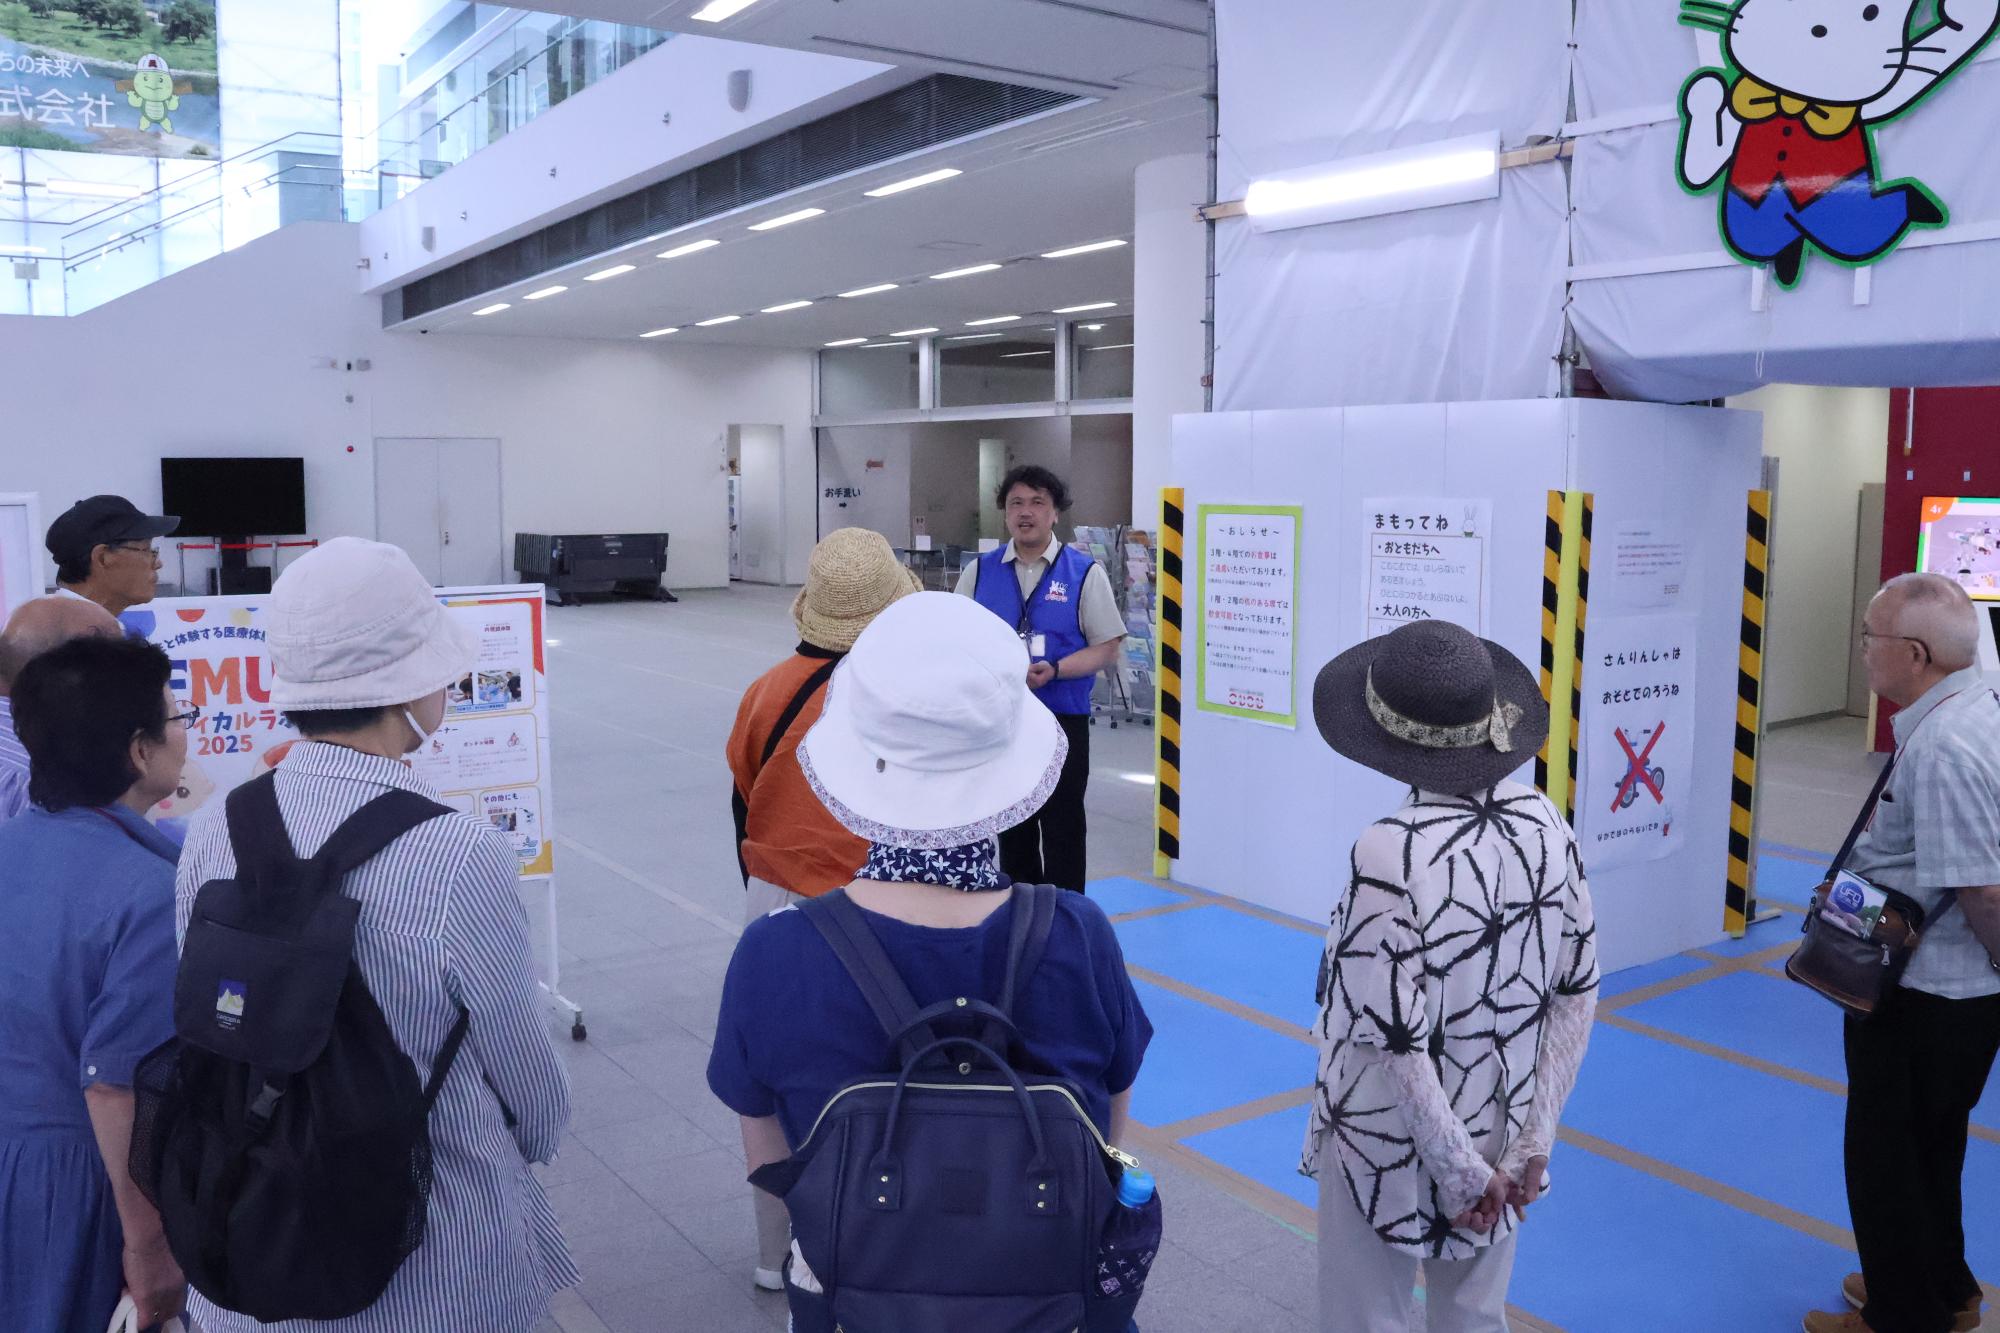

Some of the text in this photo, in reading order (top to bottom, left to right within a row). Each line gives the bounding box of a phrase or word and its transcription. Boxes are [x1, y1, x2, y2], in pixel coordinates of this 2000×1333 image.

[0, 84, 117, 128] 式会社
[1374, 514, 1449, 531] まもってね
[159, 627, 267, 652] と体験する医療体
[1604, 647, 1681, 667] さんりんしゃは
[1602, 684, 1680, 705] おそとでのろうね
[191, 709, 293, 735] ィカルラ
[197, 734, 253, 756] 2025
[1839, 885, 1861, 904] UFO
